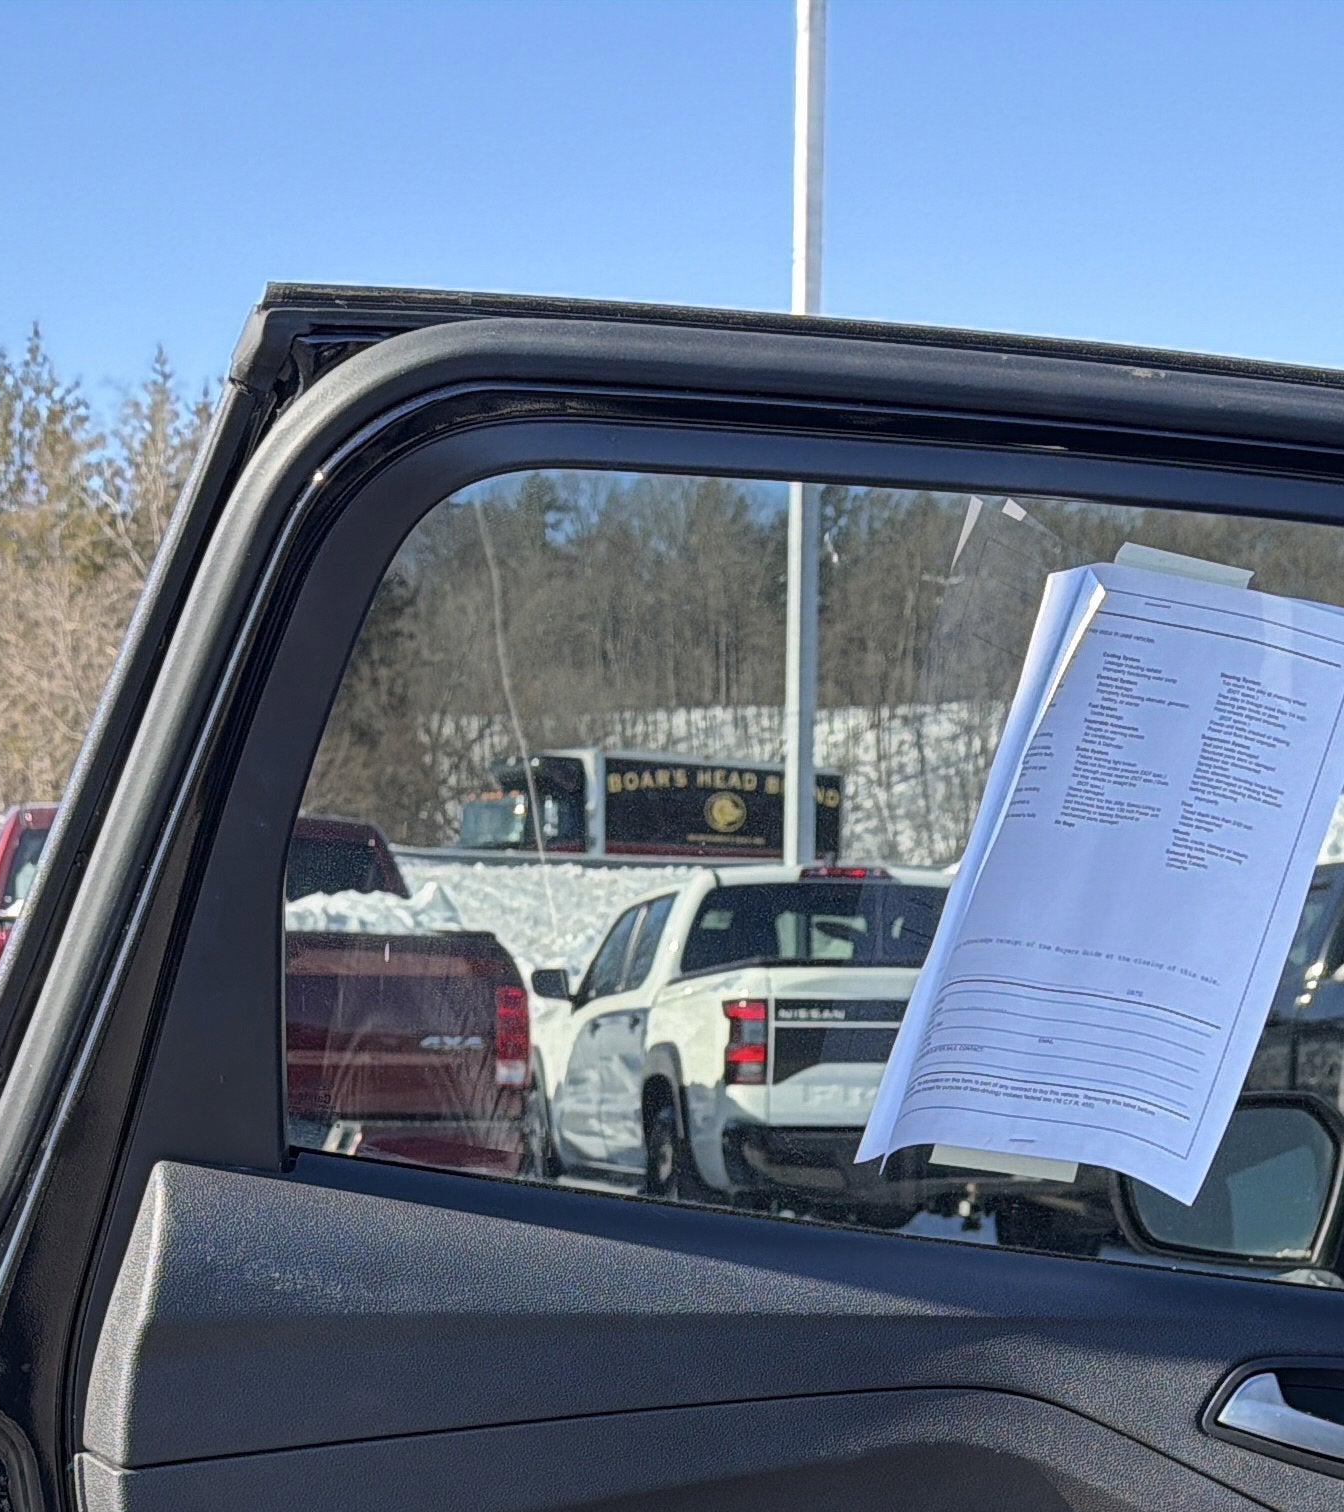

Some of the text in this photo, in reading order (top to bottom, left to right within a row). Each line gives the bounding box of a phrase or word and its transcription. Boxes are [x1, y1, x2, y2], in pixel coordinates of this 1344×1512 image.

[607, 767, 688, 793] BOAR'S
[696, 768, 758, 792] HEAD
[778, 1008, 846, 1020] NISSAN
